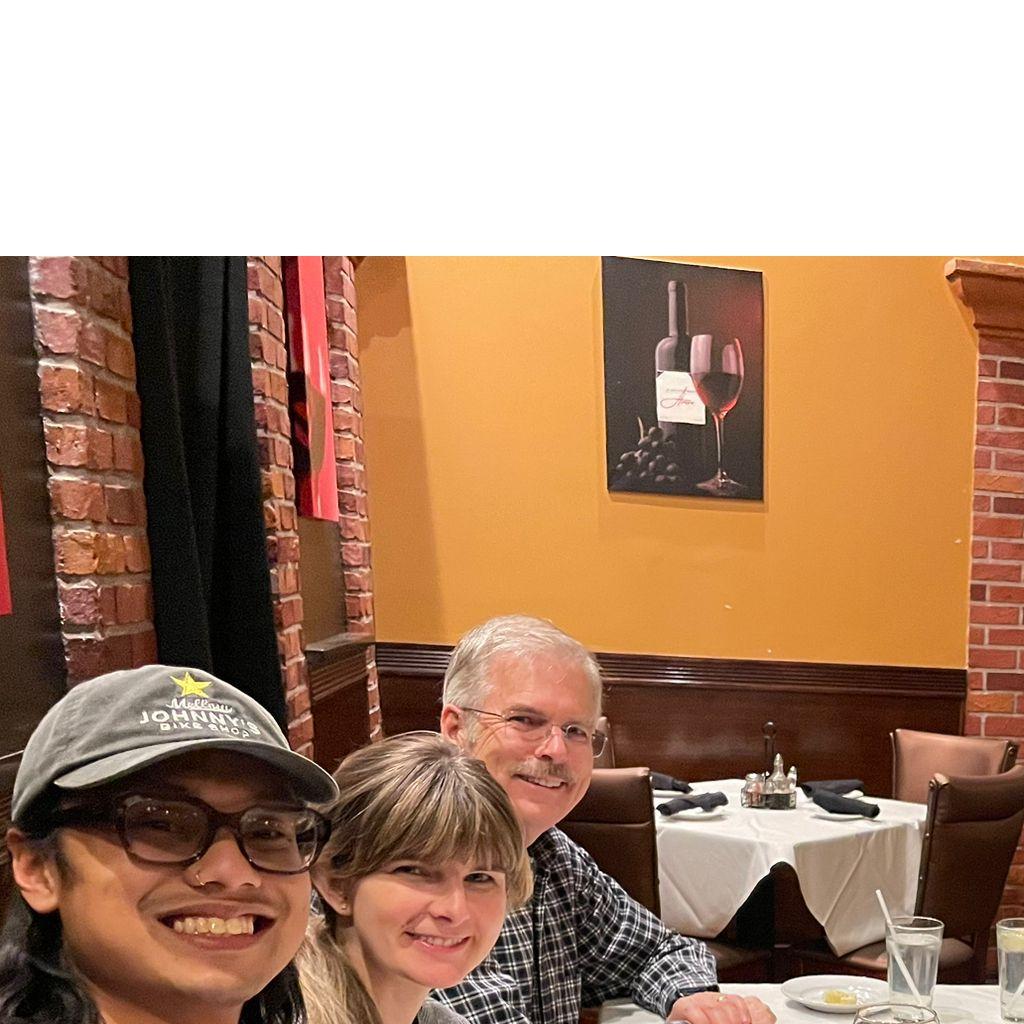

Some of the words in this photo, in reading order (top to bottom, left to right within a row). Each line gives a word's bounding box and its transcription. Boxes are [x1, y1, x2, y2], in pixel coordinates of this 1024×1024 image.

[140, 709, 261, 735] JOHNNY'S
[160, 722, 203, 731] BIKE
[208, 723, 250, 738] SHOP
